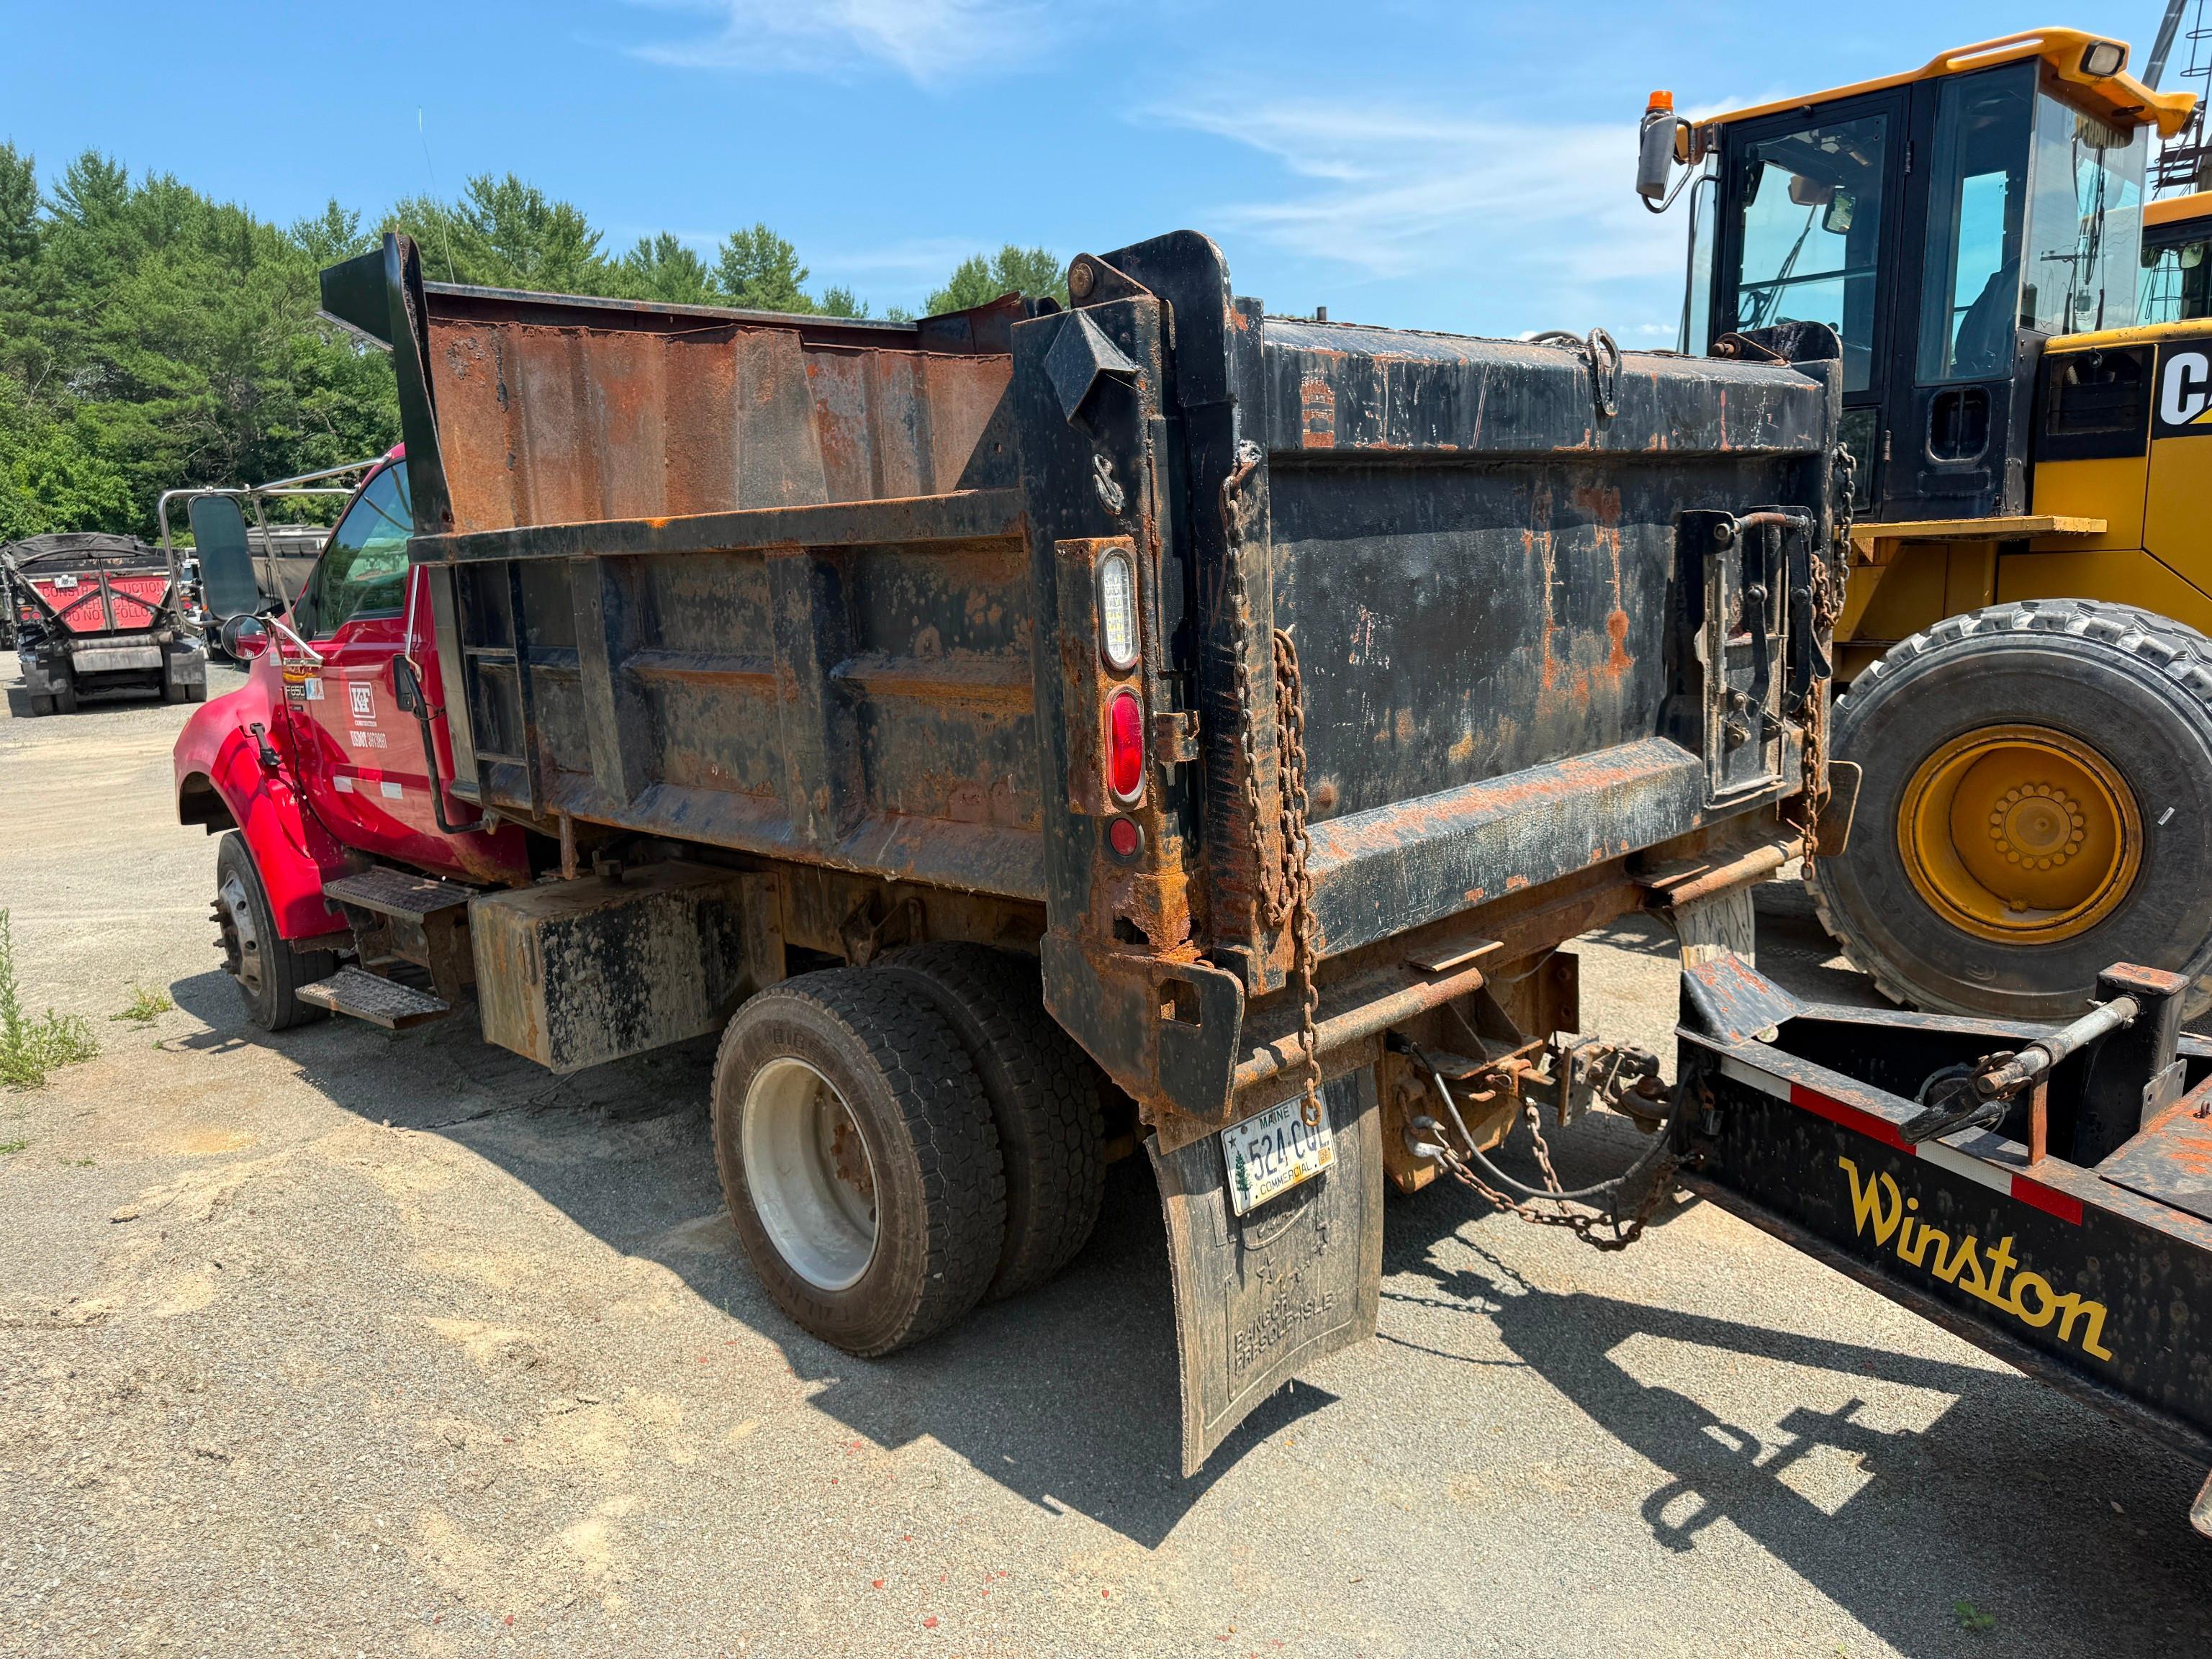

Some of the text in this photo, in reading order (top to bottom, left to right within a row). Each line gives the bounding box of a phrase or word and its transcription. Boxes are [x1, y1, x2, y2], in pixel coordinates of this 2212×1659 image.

[2161, 353, 2212, 425] C
[350, 730, 368, 748] USDOT
[1260, 1106, 1290, 1130] MAINE
[1248, 1126, 1288, 1181] 524
[1260, 1161, 1313, 1195] COMMERCIAL
[1838, 1155, 2113, 1362] Winston
